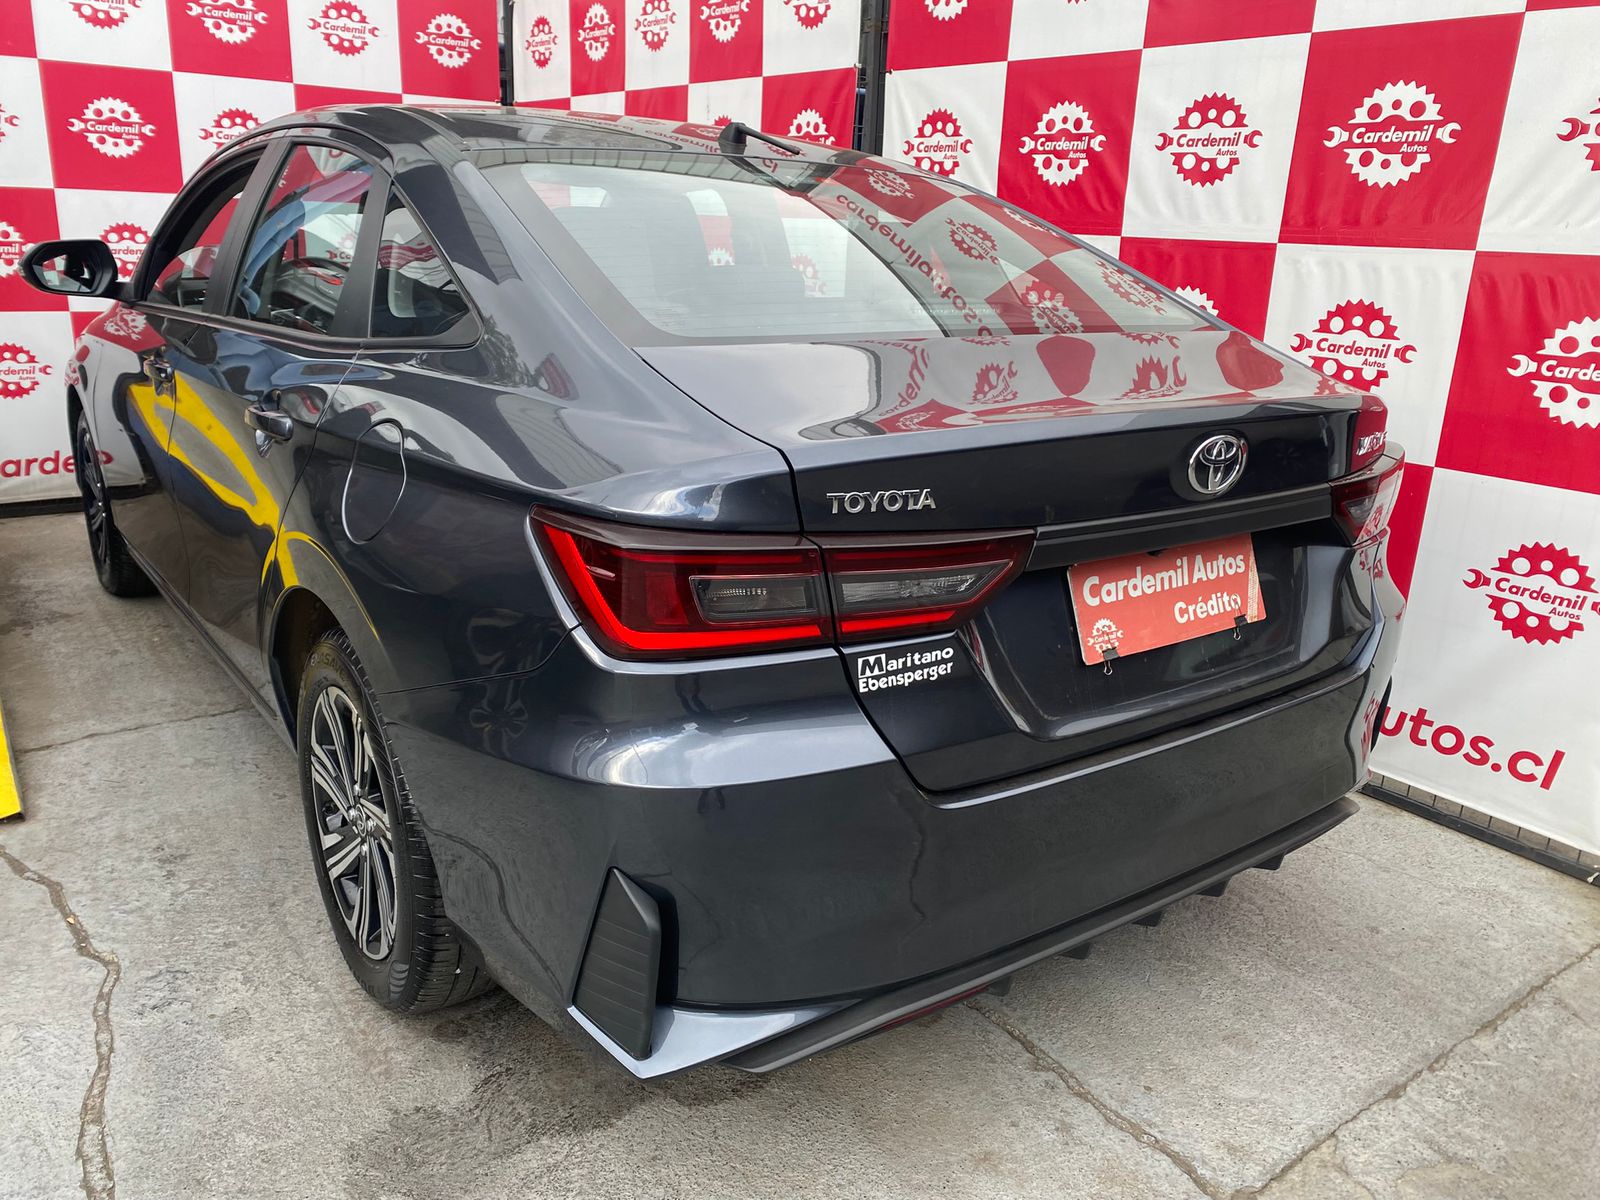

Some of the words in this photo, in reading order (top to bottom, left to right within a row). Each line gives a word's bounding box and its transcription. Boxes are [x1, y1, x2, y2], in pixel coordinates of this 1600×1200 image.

[203, 6, 252, 20] Cardemil
[323, 21, 366, 35] Cardemil
[430, 35, 469, 47] Cardemil
[87, 121, 139, 133] Cardemil
[1352, 125, 1434, 143] Cardemil
[916, 141, 959, 153] Cardemil
[1037, 135, 1089, 152] Cardemil
[1176, 131, 1241, 149] Cardemil
[1399, 143, 1428, 153] Autos
[1068, 150, 1087, 159] Autos
[1215, 147, 1238, 157] Autos
[1316, 338, 1391, 358] Cardemil
[1361, 358, 1386, 368] Autos
[826, 489, 936, 514] TOYOTA
[1082, 556, 1189, 607] Cardemil
[1192, 554, 1246, 584] Autos
[1495, 577, 1588, 610] Cardemil
[1173, 592, 1242, 624] Crédito
[1549, 607, 1581, 620] Autos
[858, 647, 954, 678] Maritano
[858, 661, 954, 693] Ebensperger
[1378, 704, 1566, 790] utos.cl
